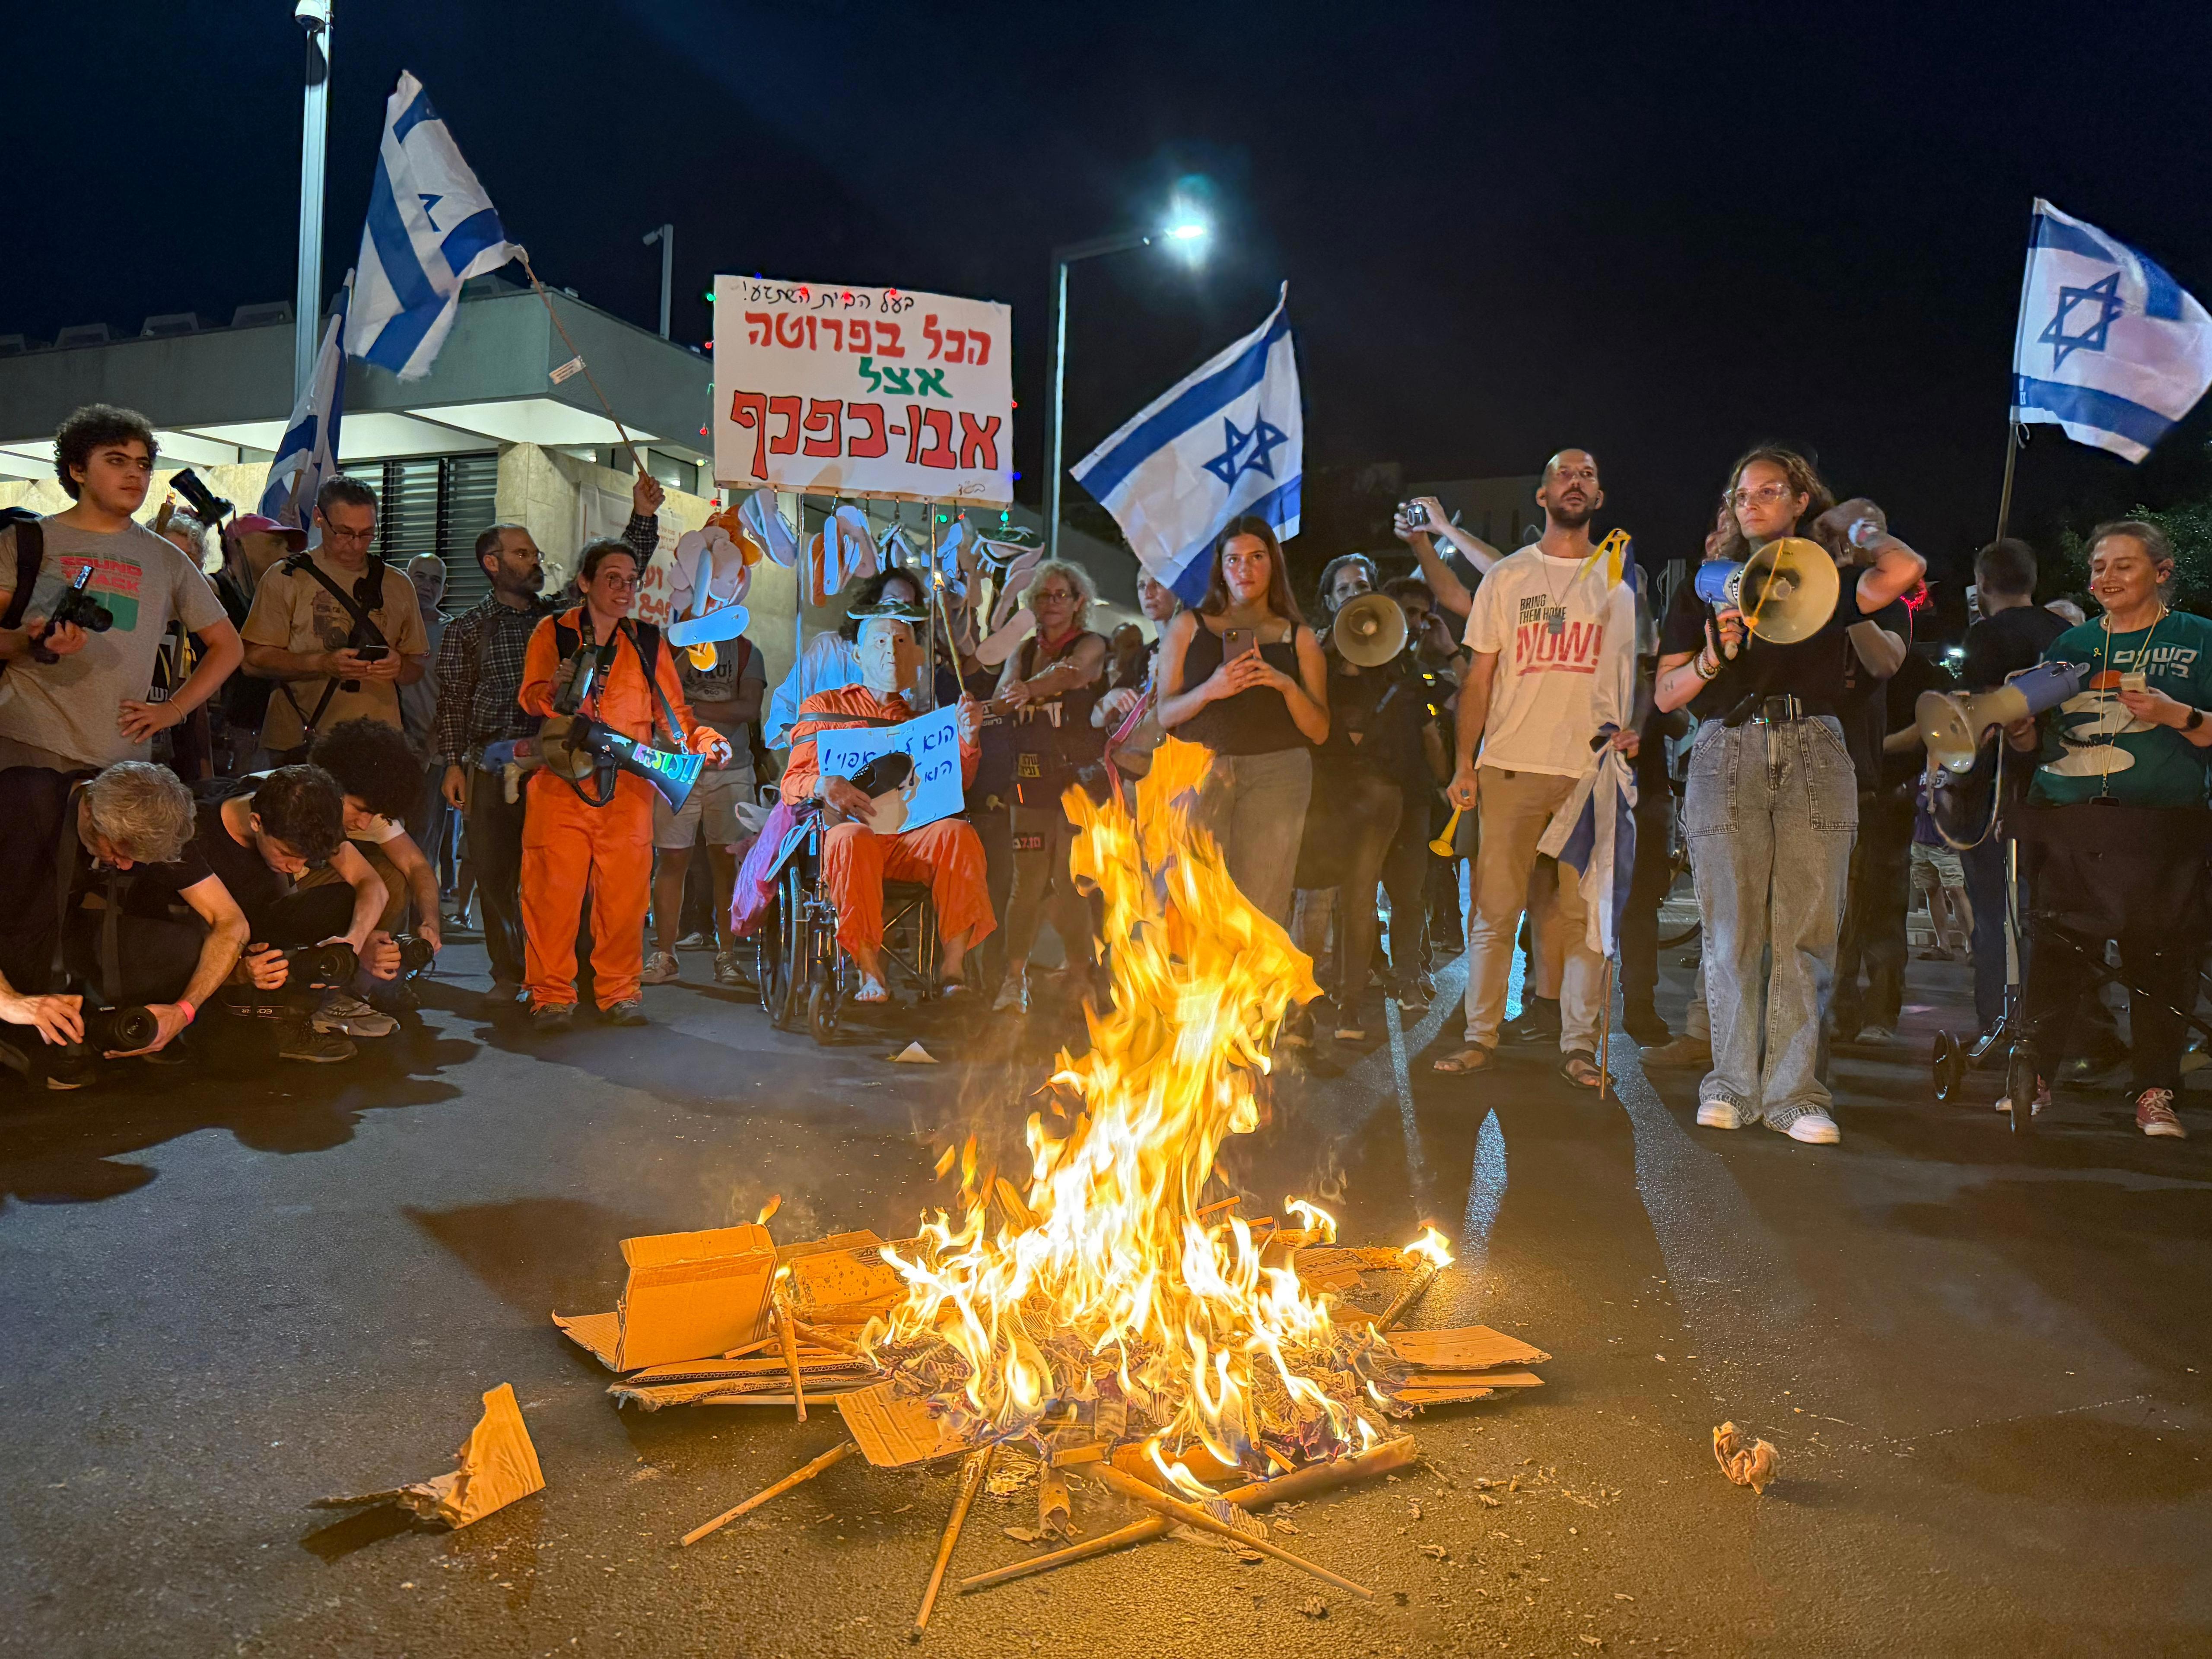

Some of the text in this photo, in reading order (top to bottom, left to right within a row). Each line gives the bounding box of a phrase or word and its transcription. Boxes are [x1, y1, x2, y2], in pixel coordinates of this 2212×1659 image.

[811, 292, 871, 310] הבית
[880, 289, 914, 313] בעל
[744, 311, 991, 365] הכל בפרוטה
[858, 356, 953, 398] אצל
[730, 390, 1001, 480] אבו-כפכף
[59, 556, 143, 577] SOUND
[61, 568, 140, 593] TACK
[1520, 594, 1547, 611] BRING
[1519, 607, 1567, 624] THEM HOME
[1516, 621, 1602, 666] NOW!
[923, 725, 954, 753] הוא
[925, 760, 953, 782] הוא
